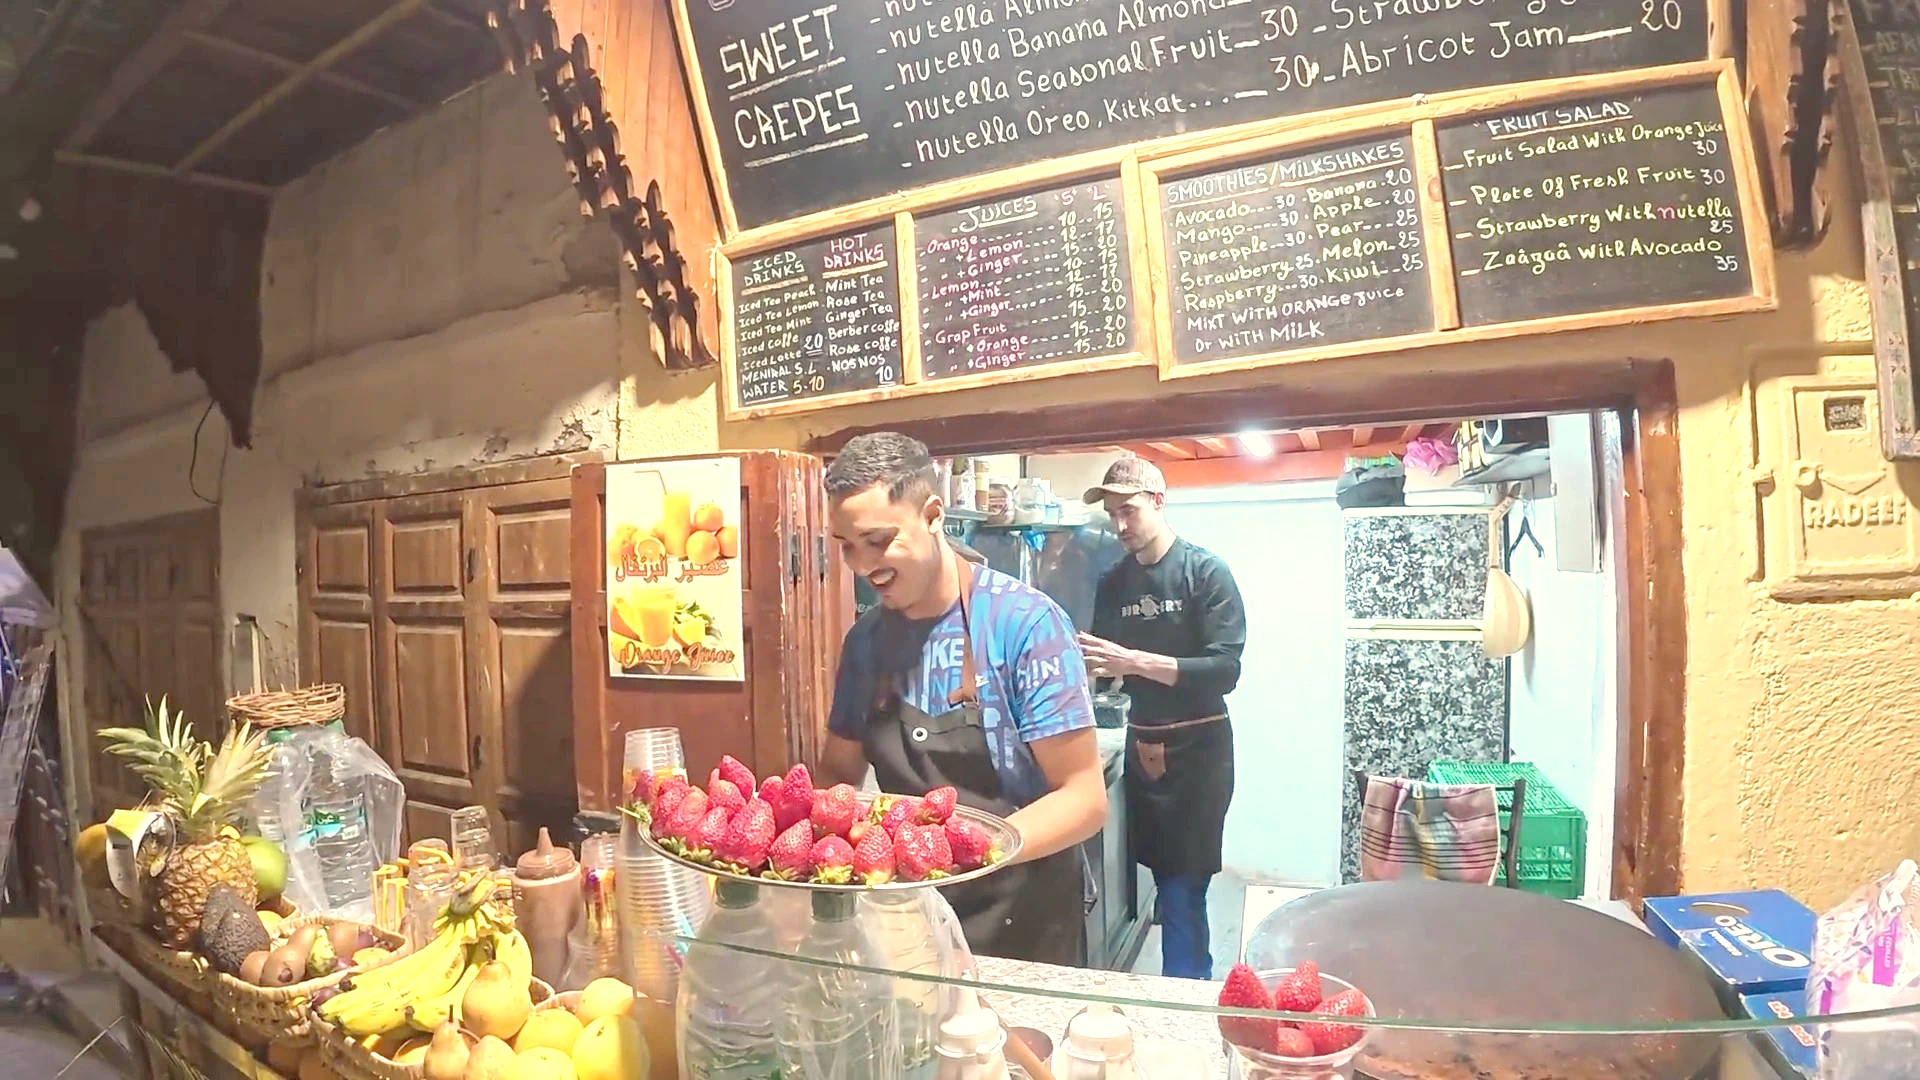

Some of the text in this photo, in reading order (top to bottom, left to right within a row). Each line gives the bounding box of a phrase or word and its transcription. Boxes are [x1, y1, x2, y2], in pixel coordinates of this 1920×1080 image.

[889, 3, 995, 48] nutella
[1341, 0, 1681, 78] Abricot Jam 20
[720, 4, 837, 90] SWEET
[897, 38, 1001, 85] nutella
[1007, 18, 1108, 58] Banana
[905, 5, 1298, 123] nutella Seasonal Fruit 30
[735, 84, 861, 148] CREPES
[916, 115, 1019, 162] nutella
[1270, 54, 1314, 91] 30
[1463, 149, 1513, 171] Fruit
[1518, 134, 1580, 158] Salad
[1582, 127, 1627, 149] With
[1631, 124, 1693, 141] Orange
[1692, 139, 1717, 156] 30
[1385, 168, 1412, 186] 20
[1470, 166, 1726, 207] Plate Of Fresh Fruit 30
[957, 195, 1037, 232] JUICES
[1175, 193, 1295, 228] Avocado 30
[1313, 188, 1415, 220] Apple 20
[927, 202, 1113, 254] Orange 10 15
[1060, 225, 1078, 242] 12
[1094, 219, 1115, 235] 17
[1176, 210, 1299, 245] Mango 30
[1315, 208, 1418, 239] Pear 25
[1476, 197, 1733, 240] Strawberry With nutella
[1710, 219, 1734, 235] 25
[823, 244, 884, 269] DRINKS
[830, 233, 868, 253] HOT
[1061, 241, 1080, 257] 15
[1097, 234, 1117, 249] 20
[1178, 231, 1306, 268] Pineapple 30
[1322, 230, 1420, 262] Melon 25
[1577, 240, 1626, 262] With
[1630, 237, 1723, 259] Avocado
[744, 260, 806, 287] DRINKS
[752, 251, 797, 272] ICED
[931, 248, 1118, 300] Lemon 10 15
[1065, 269, 1084, 283] 12
[1099, 263, 1118, 279] 17
[1180, 253, 1314, 291] Strawberry 25
[1325, 253, 1424, 283] Kiwi 25
[1714, 255, 1739, 272] 35
[825, 273, 884, 293] Mint Tea
[862, 289, 885, 302] Tea
[1066, 282, 1084, 298] 15
[1100, 277, 1123, 293] 20
[1184, 274, 1318, 312] Raspberry 30
[786, 300, 819, 317] Lemon
[825, 303, 894, 324] Ginger Tea
[1067, 299, 1087, 317] 15
[1102, 294, 1127, 312] 20
[786, 316, 812, 330] Mint
[1069, 320, 1089, 338] 15
[1103, 313, 1127, 331] 20
[804, 333, 823, 350] 20
[1073, 337, 1091, 354] 15
[1105, 331, 1126, 348] 20
[875, 365, 893, 382] 10
[743, 379, 789, 400] WATER
[675, 558, 730, 583] عصير
[619, 641, 736, 674] Orange Juice
[1714, 915, 1812, 968] OREO
